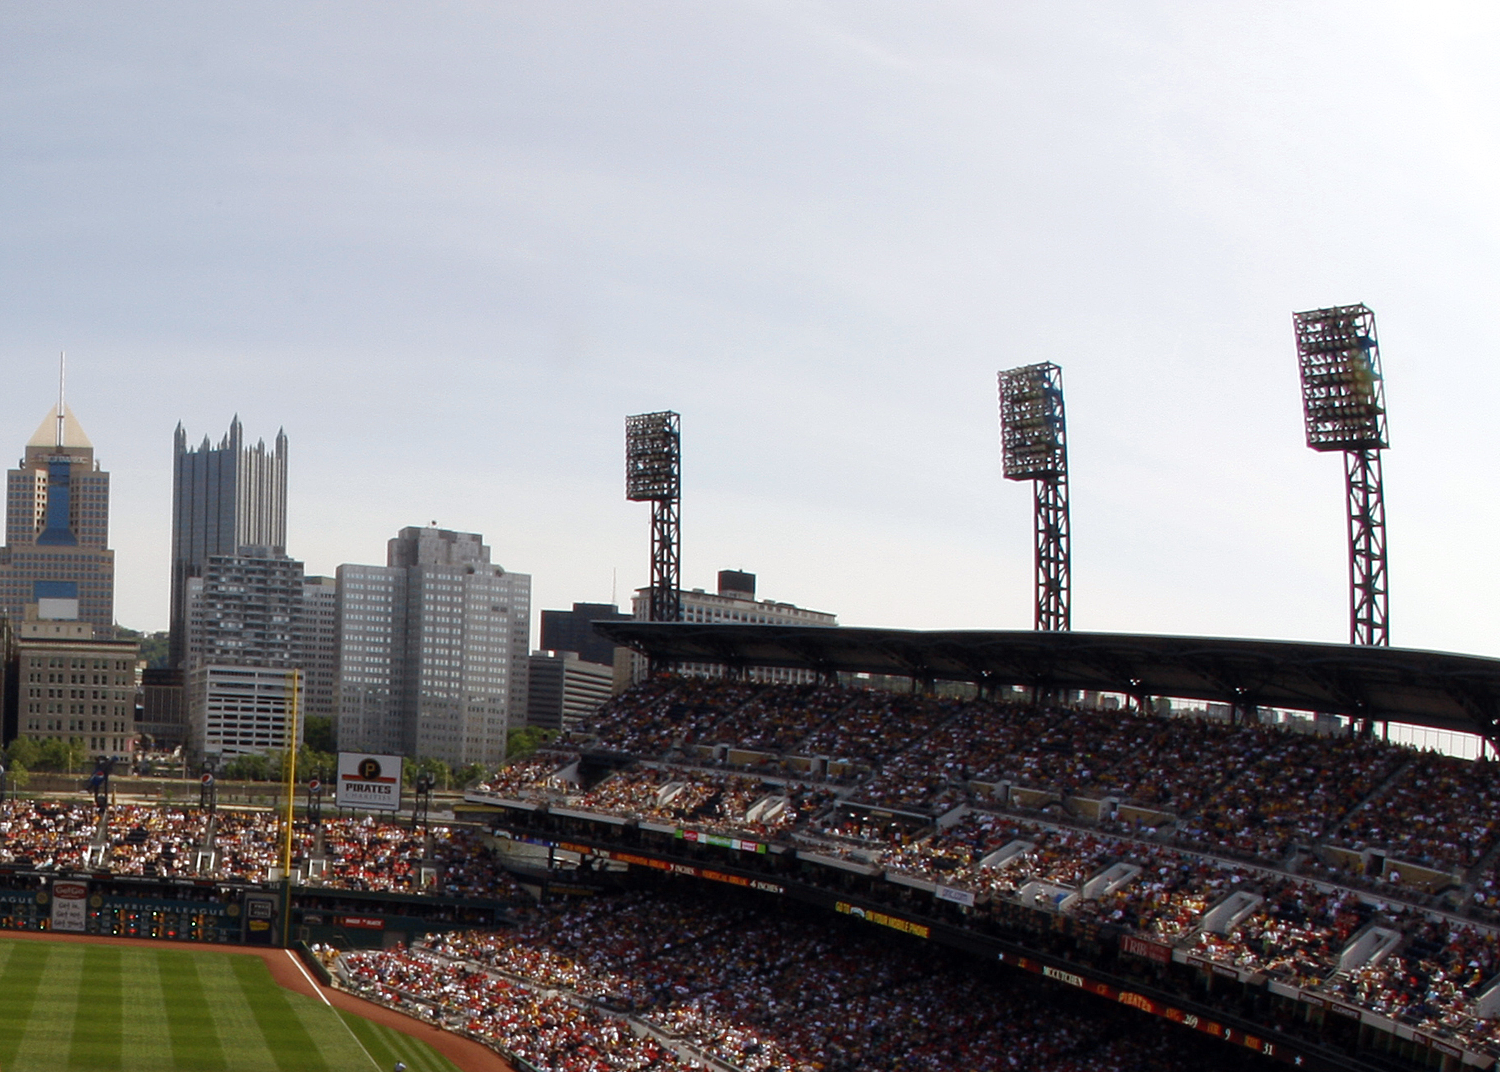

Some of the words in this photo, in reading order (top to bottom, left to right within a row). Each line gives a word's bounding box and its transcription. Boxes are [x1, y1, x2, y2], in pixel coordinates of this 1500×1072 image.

[345, 783, 392, 795] PIRATES
[104, 902, 172, 914] AMERICAN
[175, 906, 226, 917] LEAGUE
[1224, 1028, 1232, 1041] 9
[1262, 1042, 1274, 1056] 31
